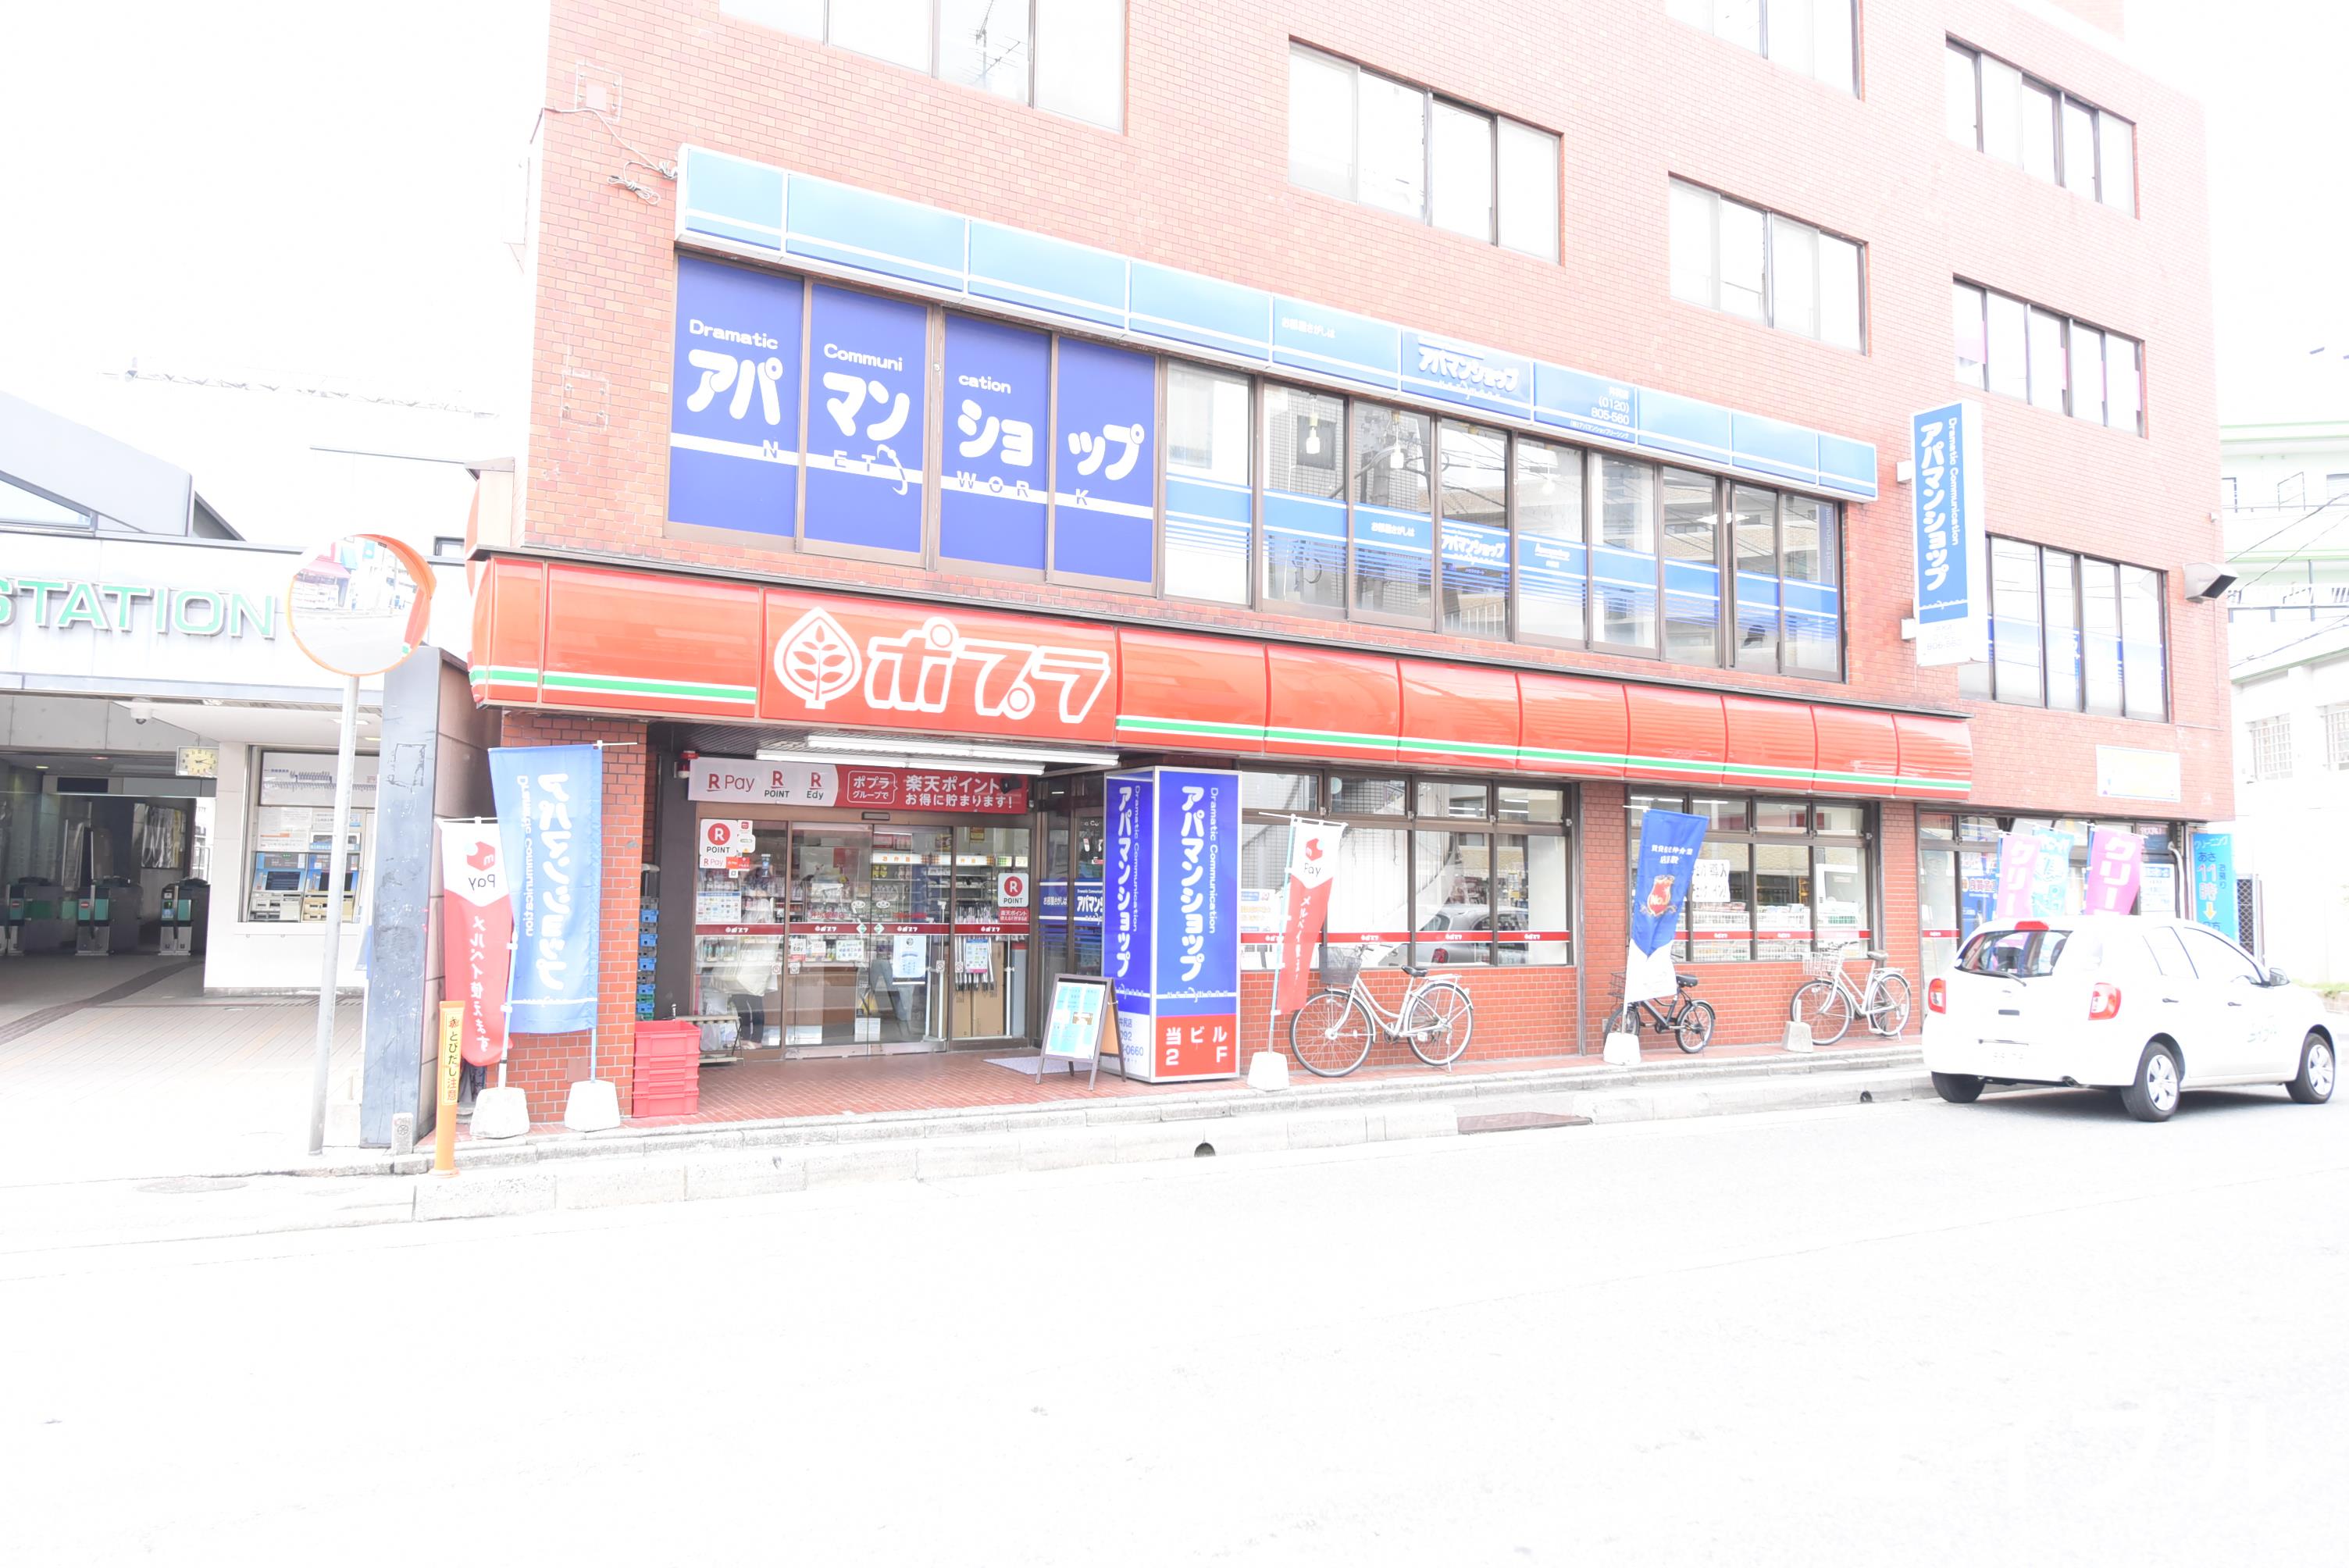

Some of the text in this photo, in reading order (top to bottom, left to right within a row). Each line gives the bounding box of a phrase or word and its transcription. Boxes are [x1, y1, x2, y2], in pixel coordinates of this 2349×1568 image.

[689, 319, 1011, 395] Dramatic Communi cation
[1418, 346, 1520, 392] アパマンショップ
[1599, 395, 1630, 415] (0120)
[1948, 417, 1959, 547] Dramatic Communication
[1921, 422, 1950, 591] アパマンショップ
[864, 616, 1110, 725] ポプラ
[708, 773, 755, 793] R Pay
[853, 776, 889, 789] ポプラ
[905, 775, 1000, 794] 楽天ポイント
[765, 789, 790, 798] POINT
[807, 790, 824, 800] Edy
[853, 790, 889, 800] グループで
[714, 828, 725, 841] R
[1209, 787, 1218, 934] Dramatic Communication
[2198, 852, 2217, 862] あさ
[1304, 862, 1321, 877] Pay
[1010, 880, 1018, 893] R
[1117, 786, 1132, 978] アパマンショップ
[1180, 786, 1205, 982] アパマンショップ
[1166, 1025, 1228, 1046] 当ビル
[446, 1031, 459, 1102] とびだし注意
